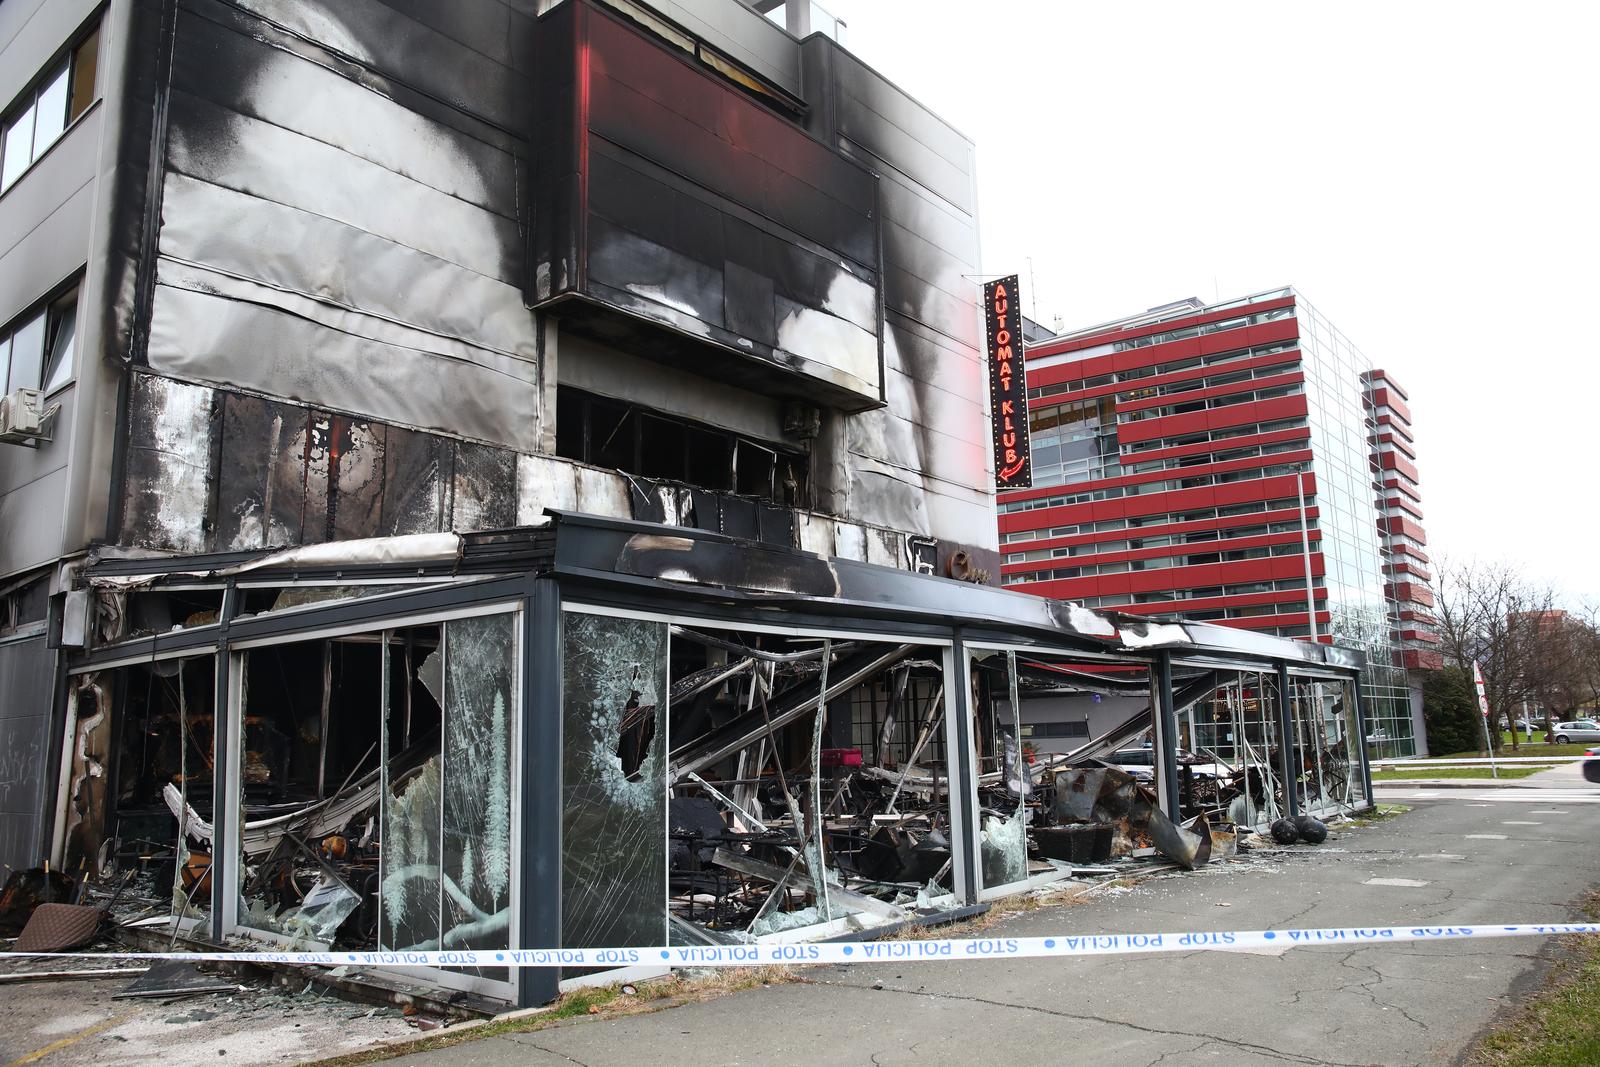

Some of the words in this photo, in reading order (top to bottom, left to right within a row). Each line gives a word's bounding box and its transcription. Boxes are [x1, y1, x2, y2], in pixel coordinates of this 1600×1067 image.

[995, 284, 1012, 391] AUTOMAT
[1001, 400, 1017, 464] KLUB
[1066, 934, 1164, 951] POLICIJA
[1178, 931, 1237, 946] STOP
[677, 947, 759, 961] POLICIJA
[771, 945, 820, 960] STOP
[862, 942, 952, 958] POLICIJA
[966, 939, 1019, 955] STOP
[363, 952, 429, 964] POLICIJA
[438, 952, 477, 964] STOP
[511, 950, 585, 964] POLICIJA
[596, 949, 640, 963] STOP
